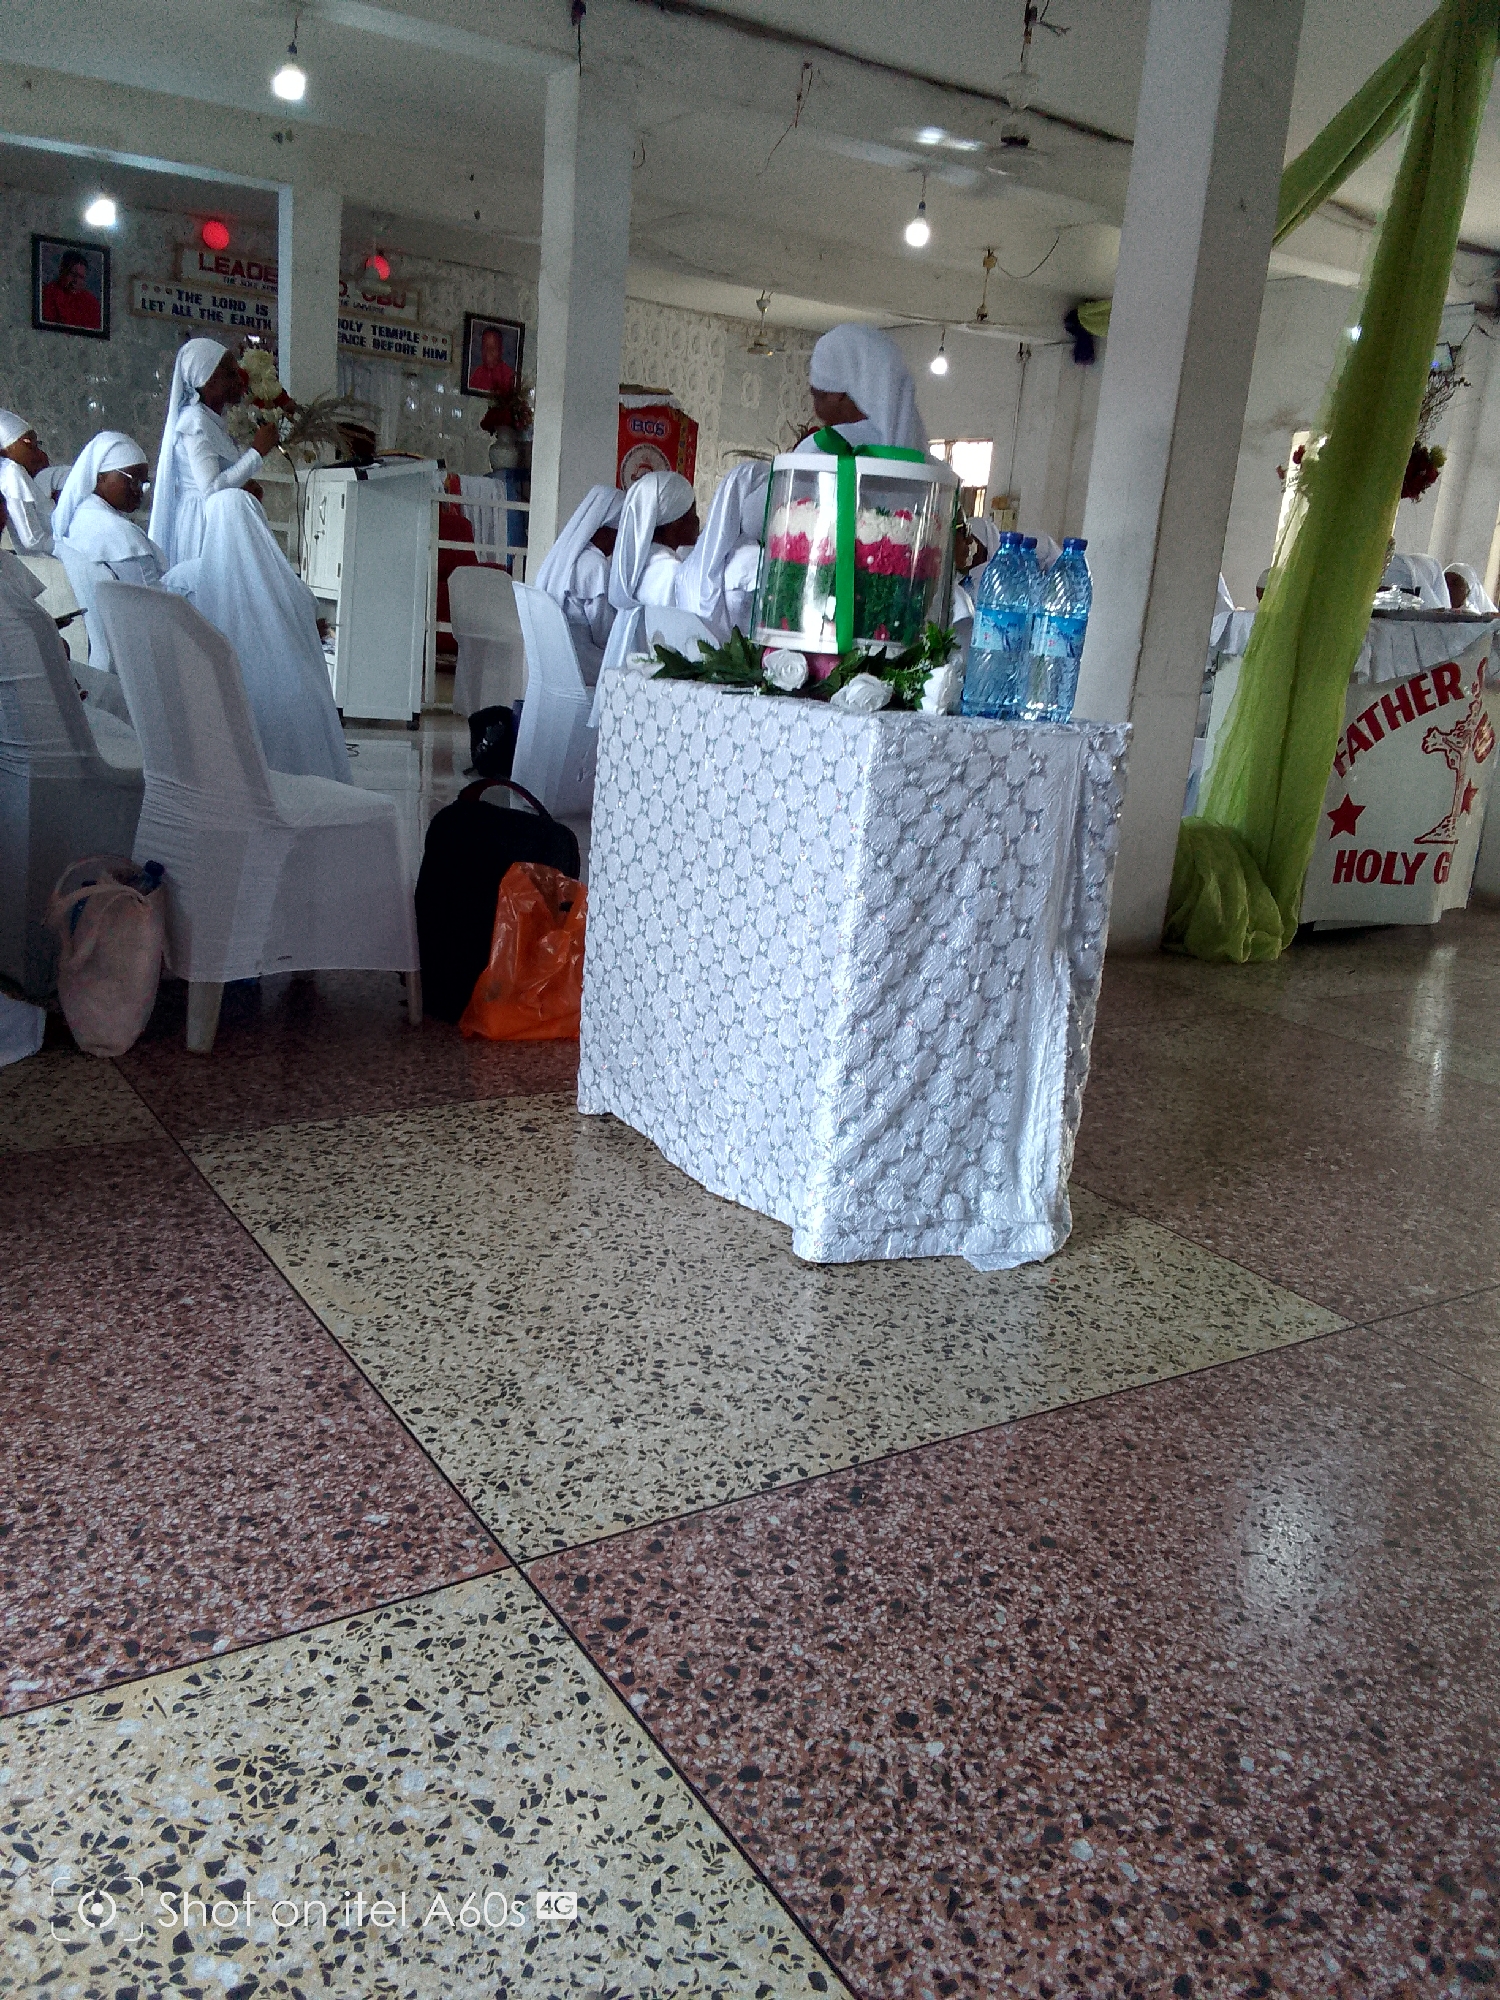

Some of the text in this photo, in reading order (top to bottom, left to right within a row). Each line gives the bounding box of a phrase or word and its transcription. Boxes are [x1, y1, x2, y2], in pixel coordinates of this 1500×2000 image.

[141, 297, 165, 313] LET
[171, 303, 192, 317] ALL
[199, 307, 224, 323] THE
[230, 313, 272, 331] EARTH
[372, 338, 418, 356] BEFORE
[423, 346, 448, 361] HIM
[176, 288, 203, 306] THE
[212, 295, 247, 313] LORD
[256, 303, 269, 317] IS
[370, 324, 420, 345] TEMPLE
[1332, 848, 1429, 885] HOLY
